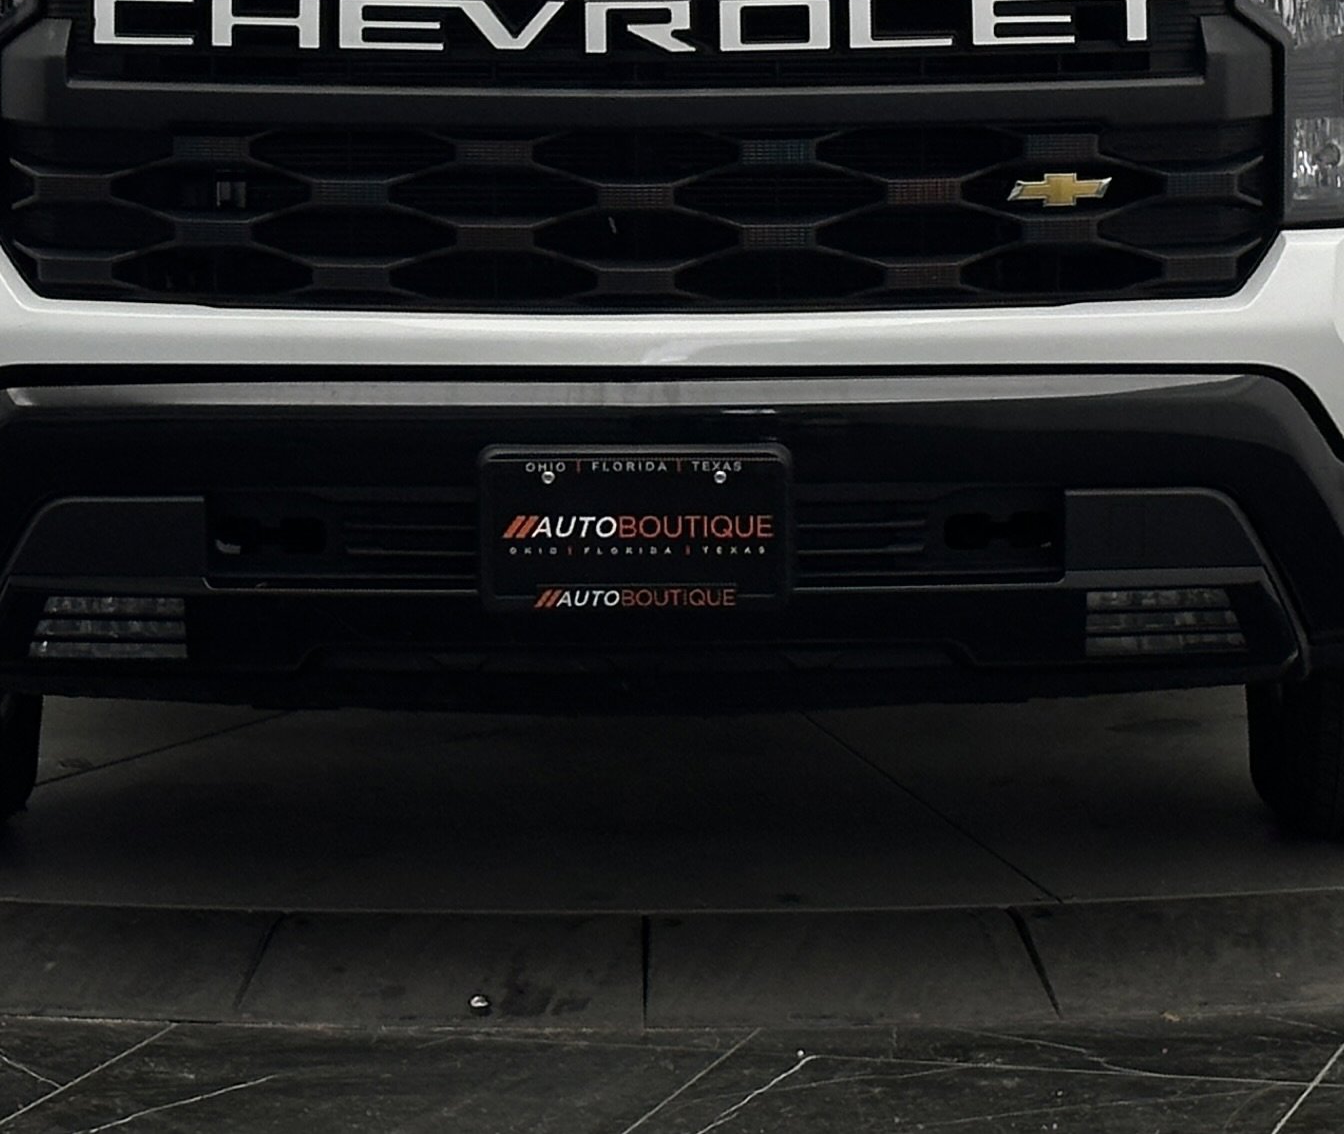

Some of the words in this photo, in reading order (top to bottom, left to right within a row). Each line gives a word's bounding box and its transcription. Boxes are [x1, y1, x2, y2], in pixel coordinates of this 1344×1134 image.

[525, 462, 566, 472] OHIO
[592, 461, 668, 472] FLORIDA
[690, 460, 743, 472] TEXAS
[531, 515, 775, 538] AUTOBOUTIQUE
